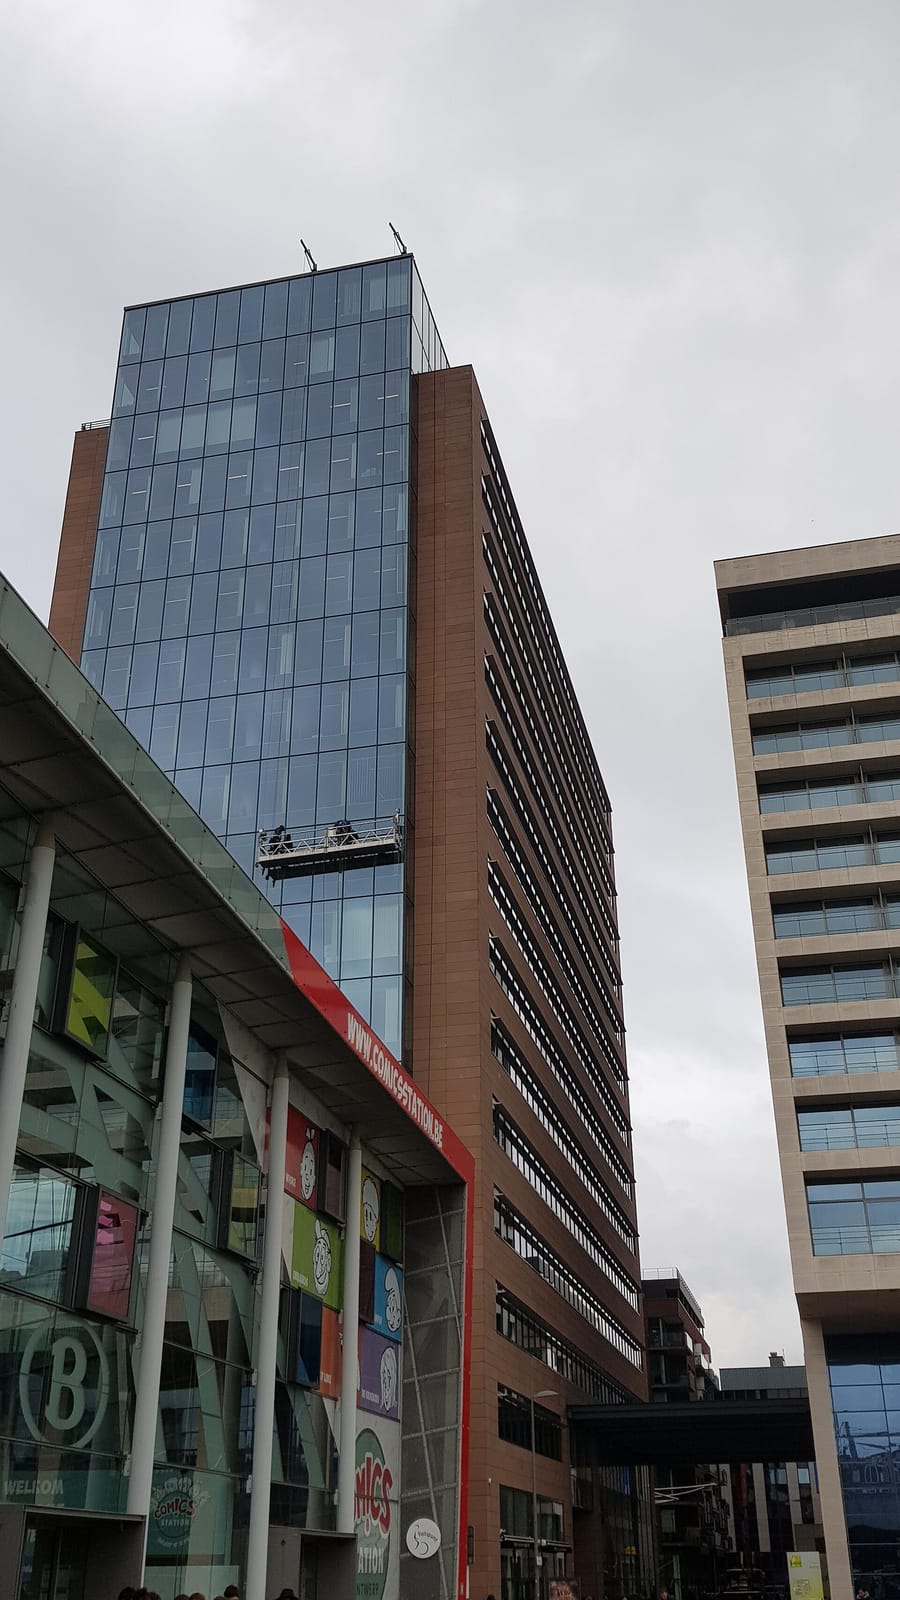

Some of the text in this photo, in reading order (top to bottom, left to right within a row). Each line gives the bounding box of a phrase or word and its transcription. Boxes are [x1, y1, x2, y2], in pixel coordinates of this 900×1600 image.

[347, 1013, 444, 1148] WWW.COMICSSTATION.BE
[45, 1336, 87, 1431] B
[4, 1479, 64, 1496] WELKOM
[354, 1456, 393, 1535] MICS
[357, 1547, 384, 1574] ATION
[356, 1583, 379, 1596] NTWERP
